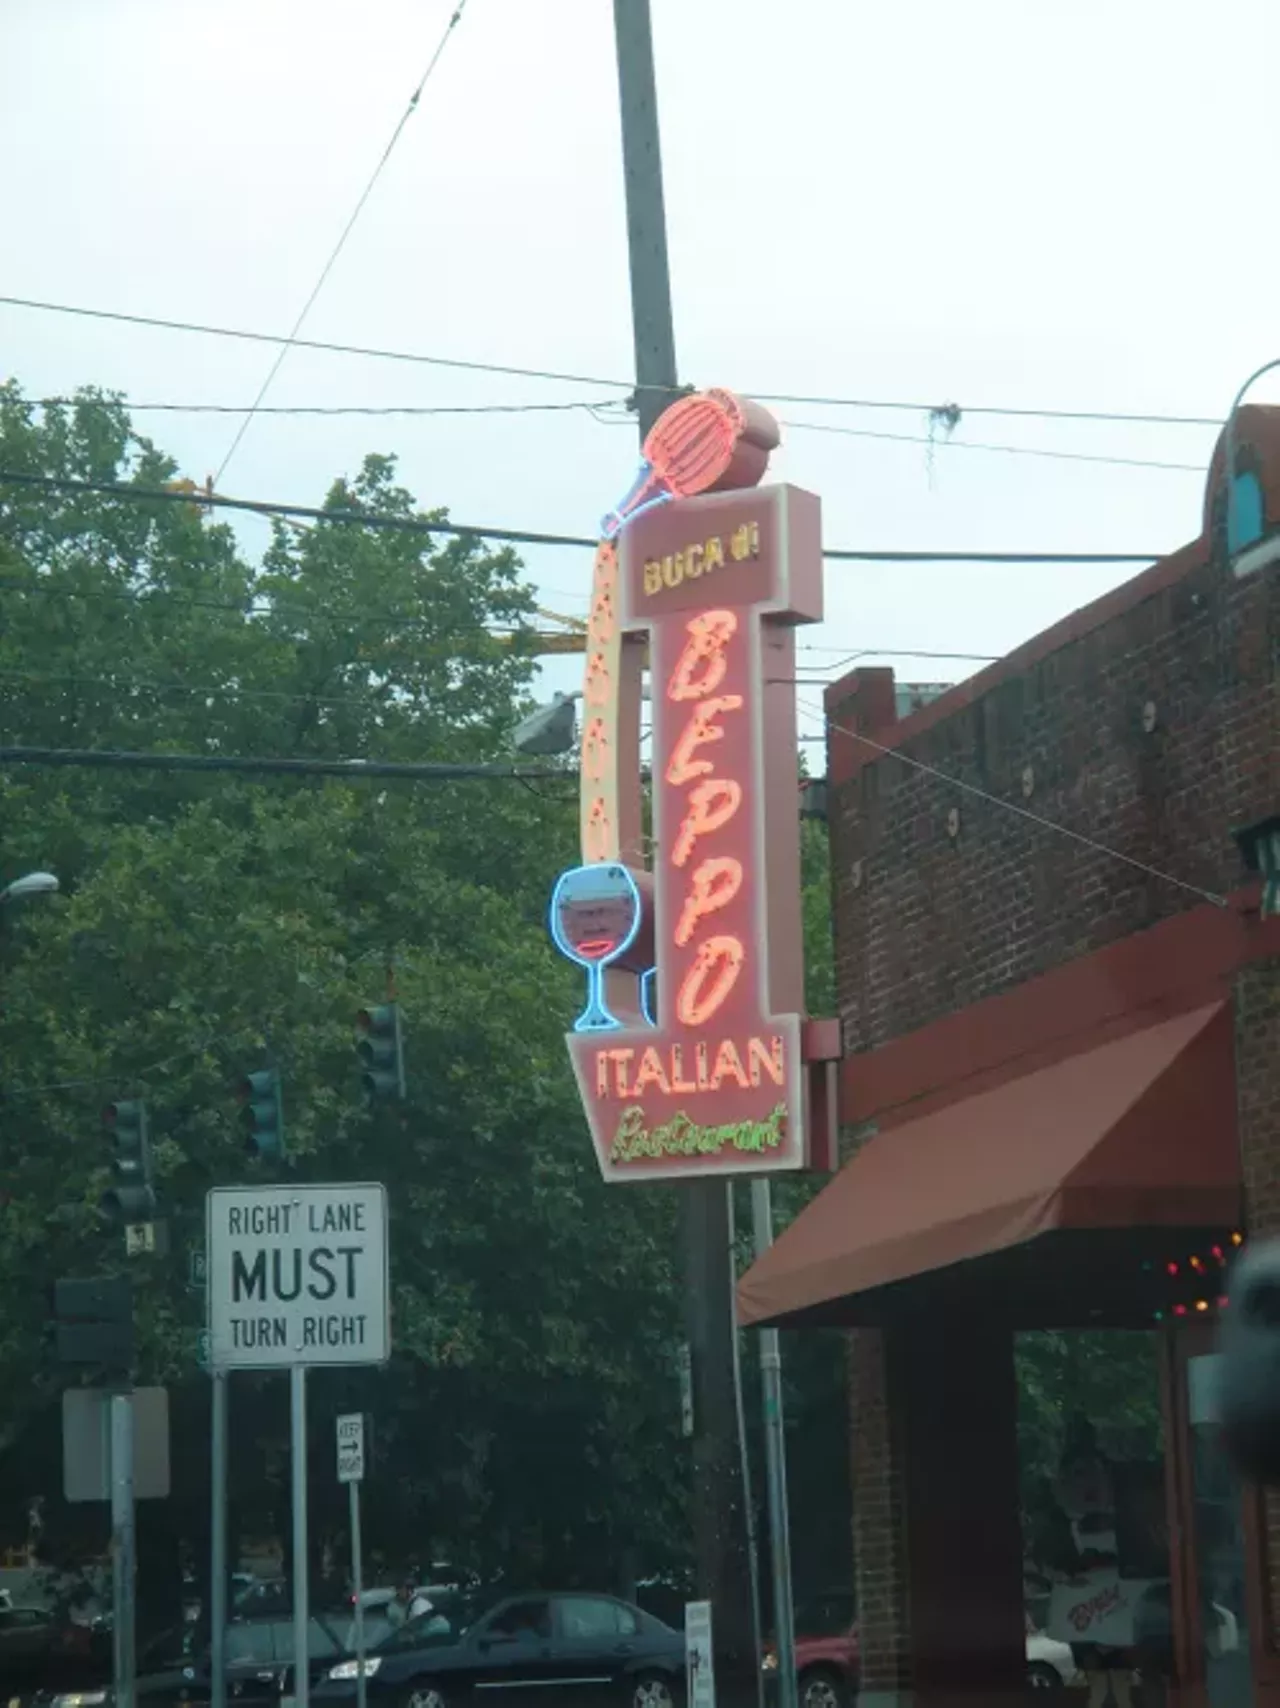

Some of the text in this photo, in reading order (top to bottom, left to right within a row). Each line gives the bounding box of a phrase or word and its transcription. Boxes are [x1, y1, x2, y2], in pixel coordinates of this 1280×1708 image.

[643, 521, 759, 597] BUCA di
[666, 609, 744, 1026] BEPPO
[595, 1035, 785, 1098] ITALIAN
[608, 1102, 788, 1166] Restaurant
[228, 1202, 366, 1236] RIGHT LANE
[231, 1246, 363, 1303] MUST
[229, 1317, 288, 1349] TURN
[302, 1315, 367, 1347] RIGHT
